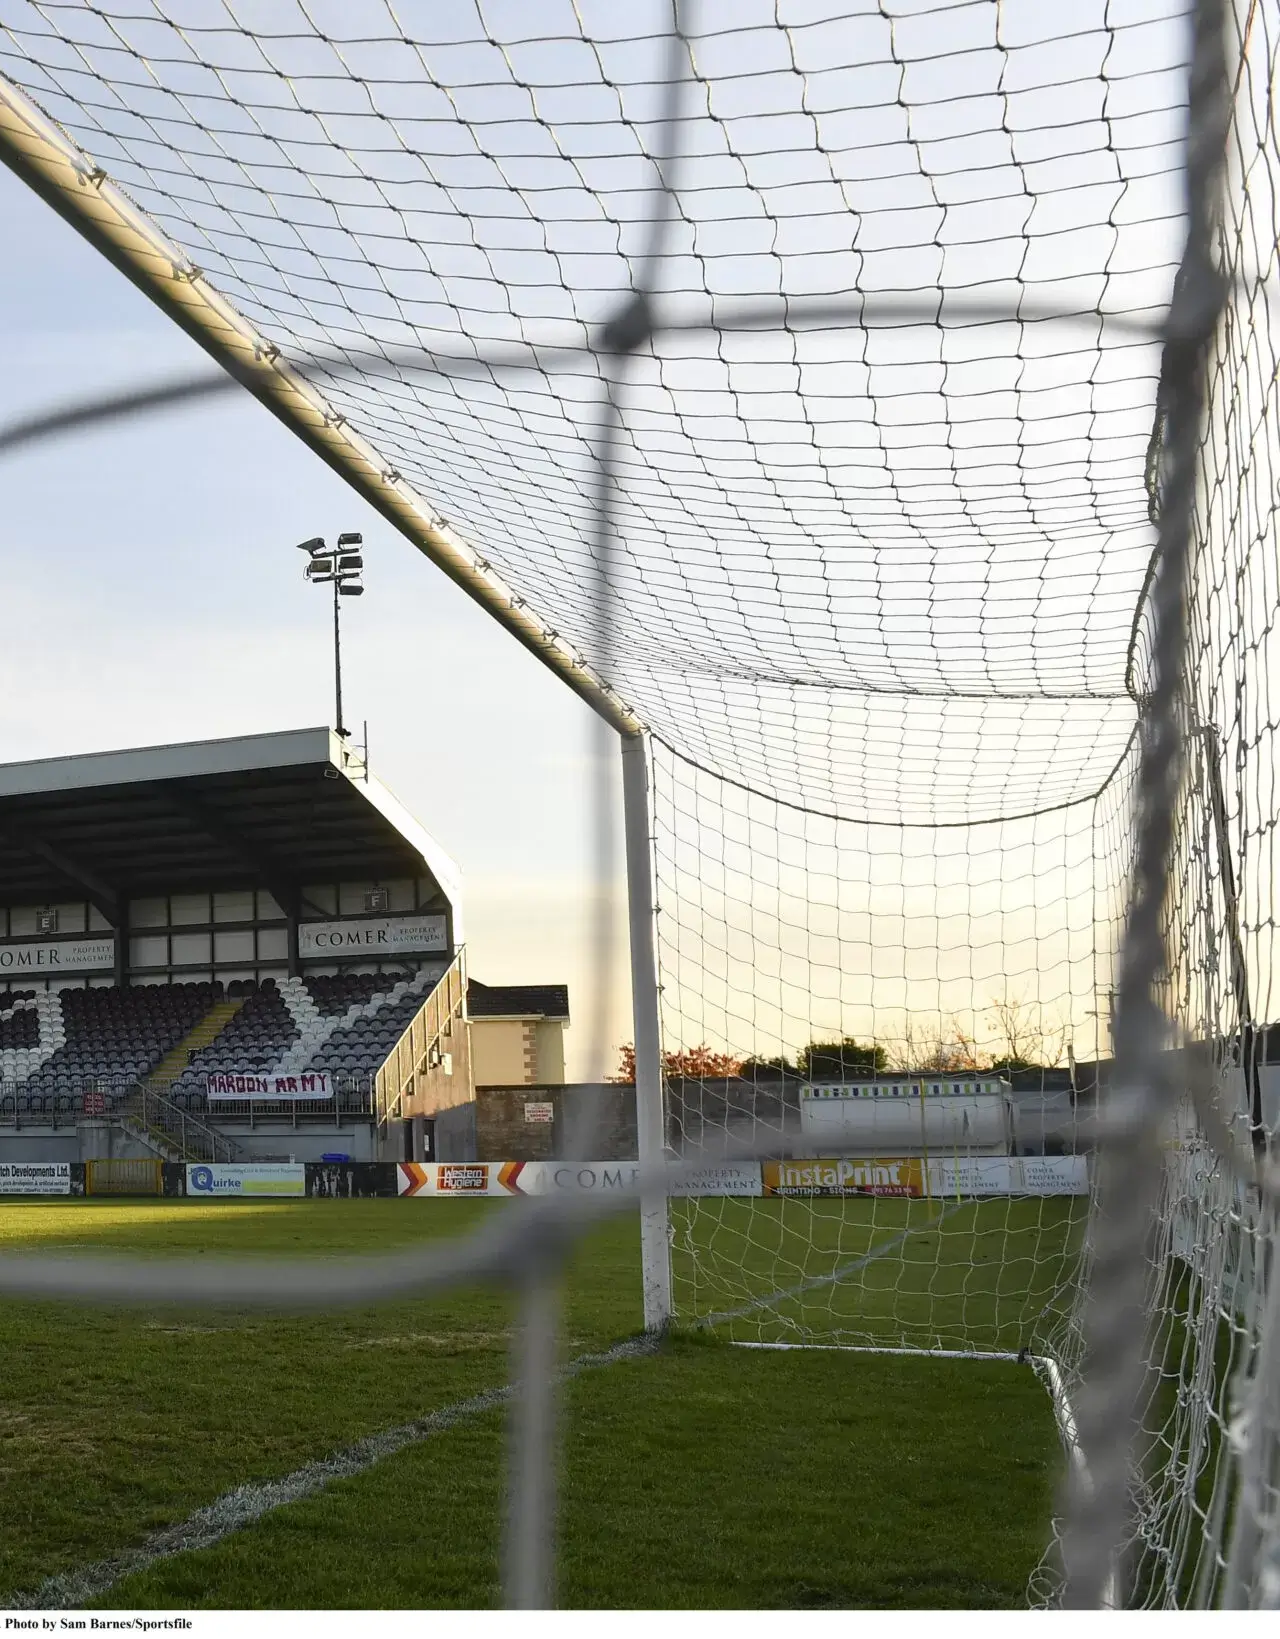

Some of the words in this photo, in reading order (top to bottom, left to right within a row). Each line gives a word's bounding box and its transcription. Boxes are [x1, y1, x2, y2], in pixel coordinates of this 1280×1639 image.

[315, 929, 389, 947] COMER
[73, 945, 111, 953] PROPERTY
[65, 954, 115, 963] MANAGEMEN
[206, 1074, 268, 1094] MAROON
[275, 1073, 328, 1093] ARMY
[11, 1165, 55, 1180] Developments
[56, 1165, 70, 1177] Ltd.
[191, 1166, 241, 1193] Quirke
[443, 1166, 482, 1178] Western
[554, 1168, 641, 1189] COME
[778, 1160, 901, 1187] InstaPrint
[443, 1177, 483, 1189] Hygiene
